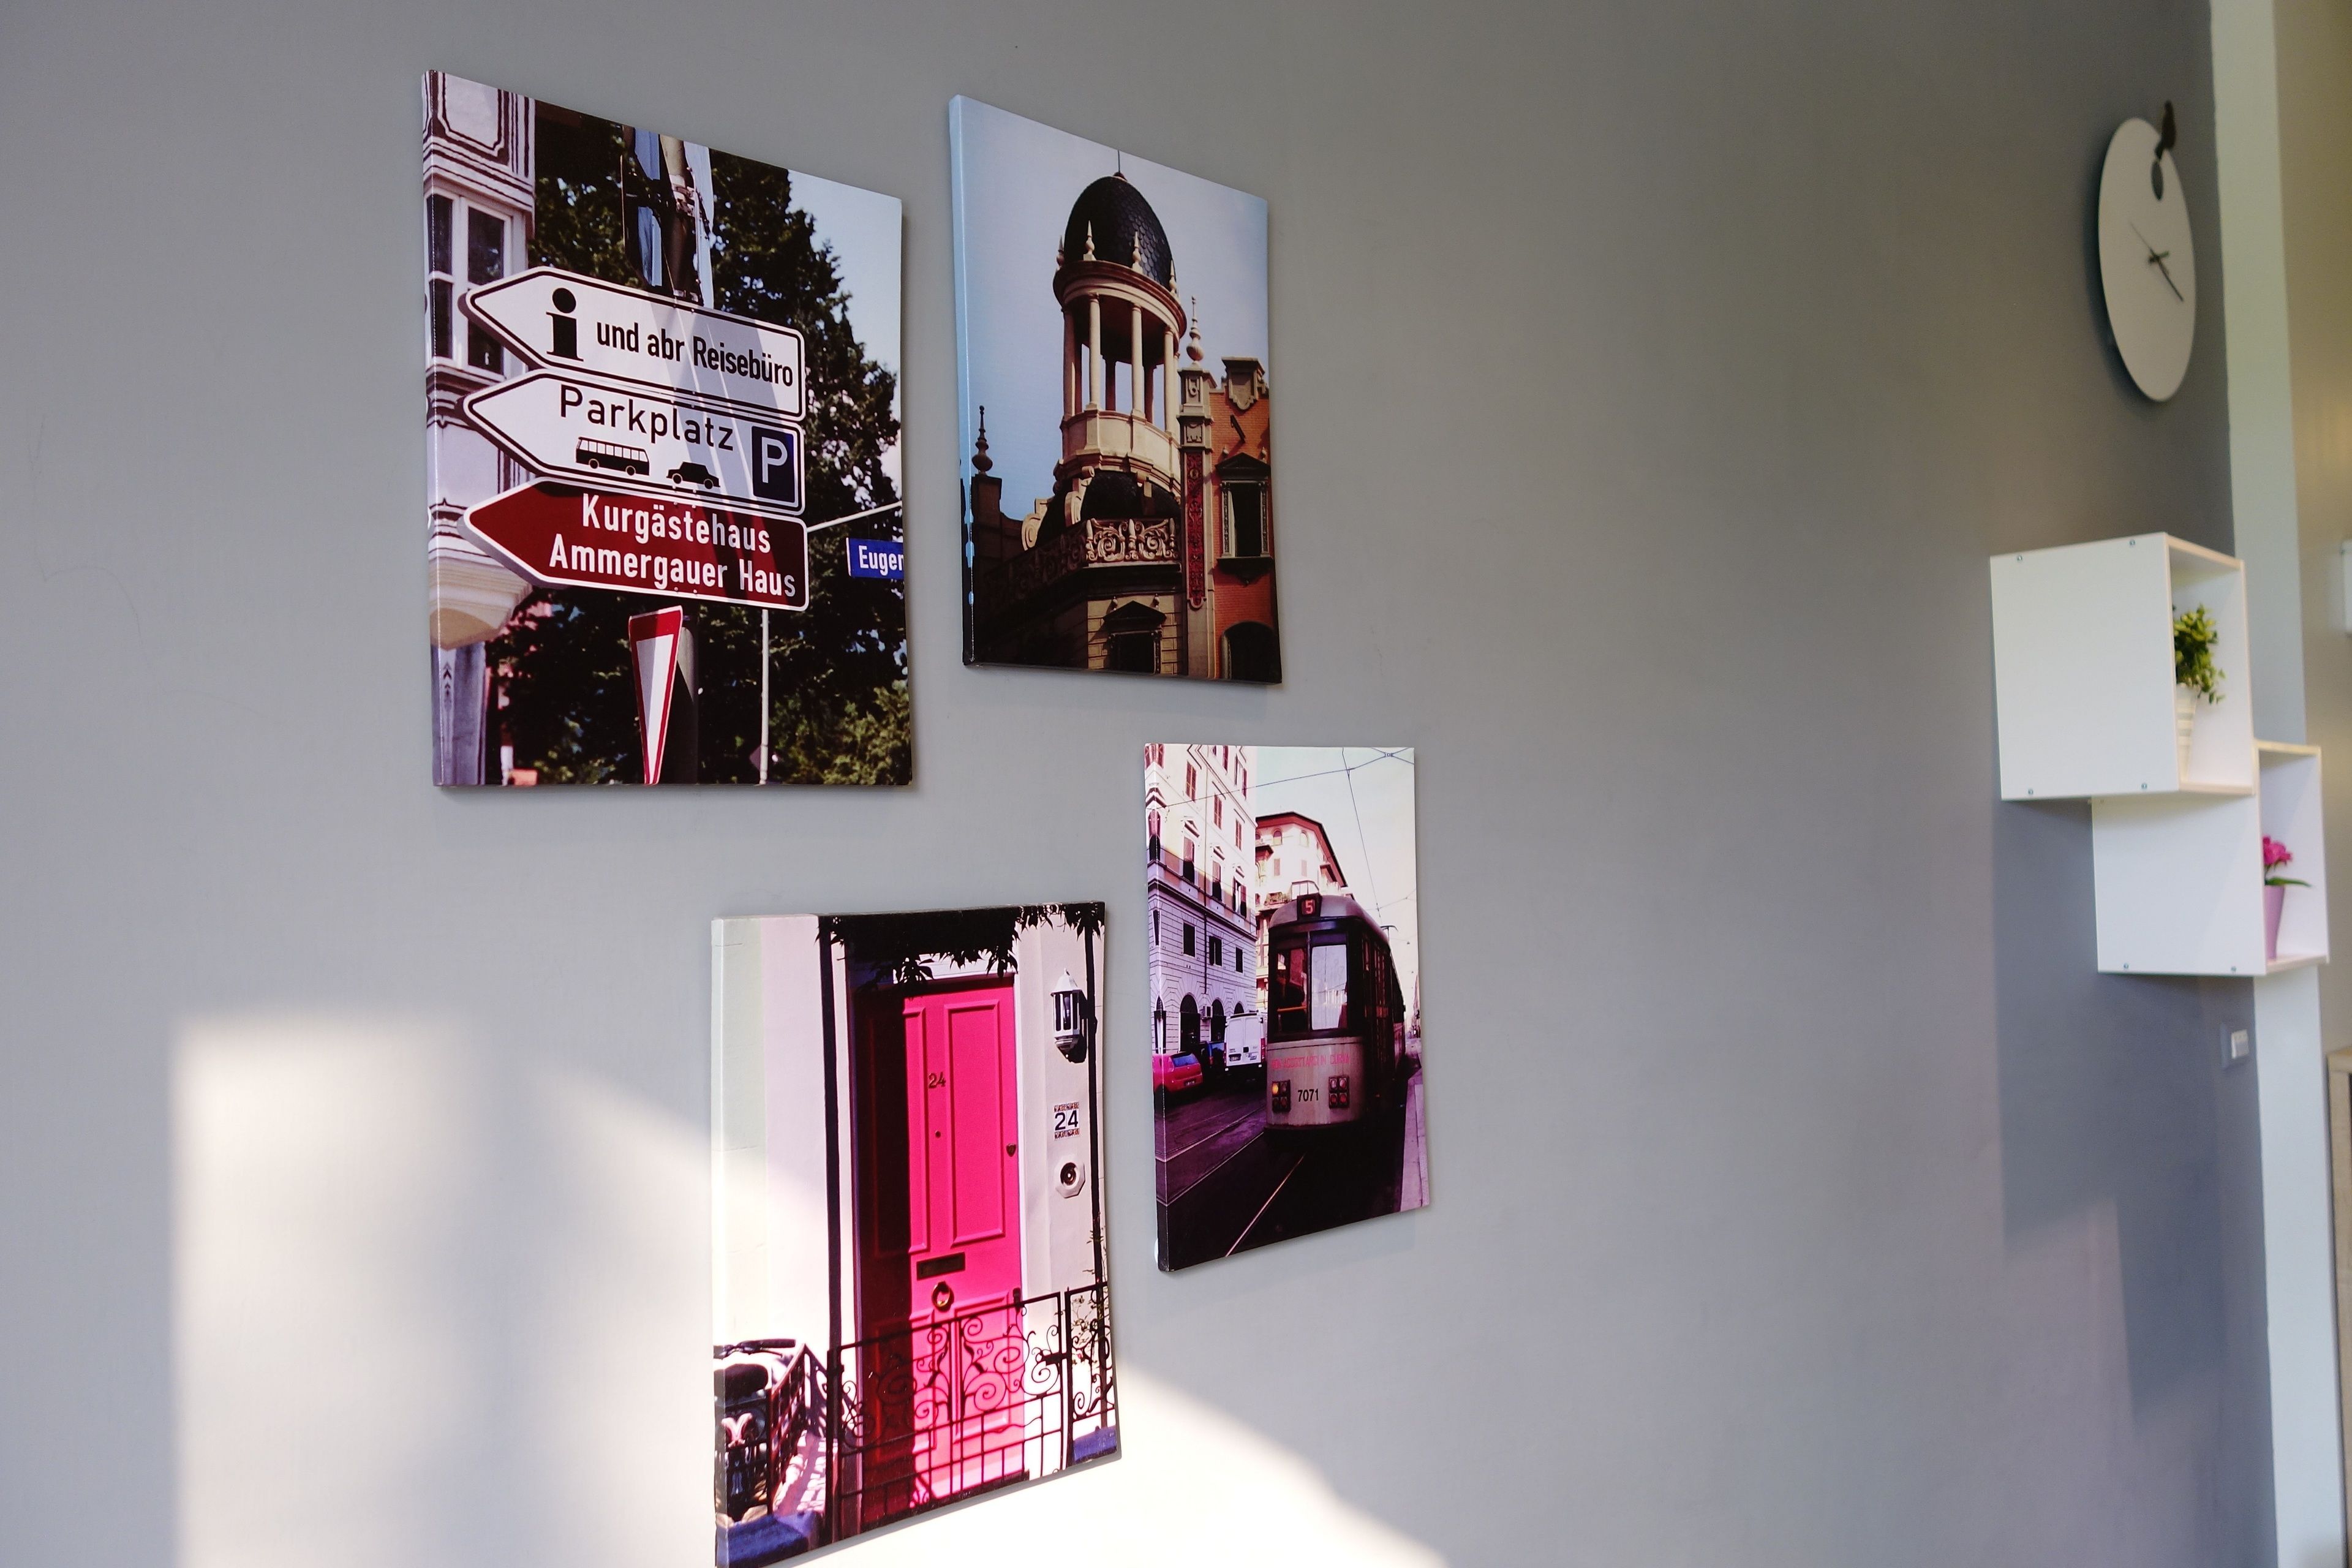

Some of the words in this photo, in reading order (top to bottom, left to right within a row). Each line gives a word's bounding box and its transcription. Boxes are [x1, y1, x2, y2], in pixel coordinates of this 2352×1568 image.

[597, 322, 639, 353] und
[647, 328, 685, 362] abr
[693, 336, 793, 386] Reisebüro
[560, 384, 734, 451] Parkplatz
[761, 436, 788, 484] P
[582, 493, 771, 553] Kurgästehaus
[549, 533, 728, 590] Ammergauer
[739, 559, 796, 597] Haus
[1305, 900, 1313, 914] 5
[929, 1072, 946, 1088] 24
[1297, 1088, 1319, 1102] 7071
[1055, 1110, 1079, 1131] 24
